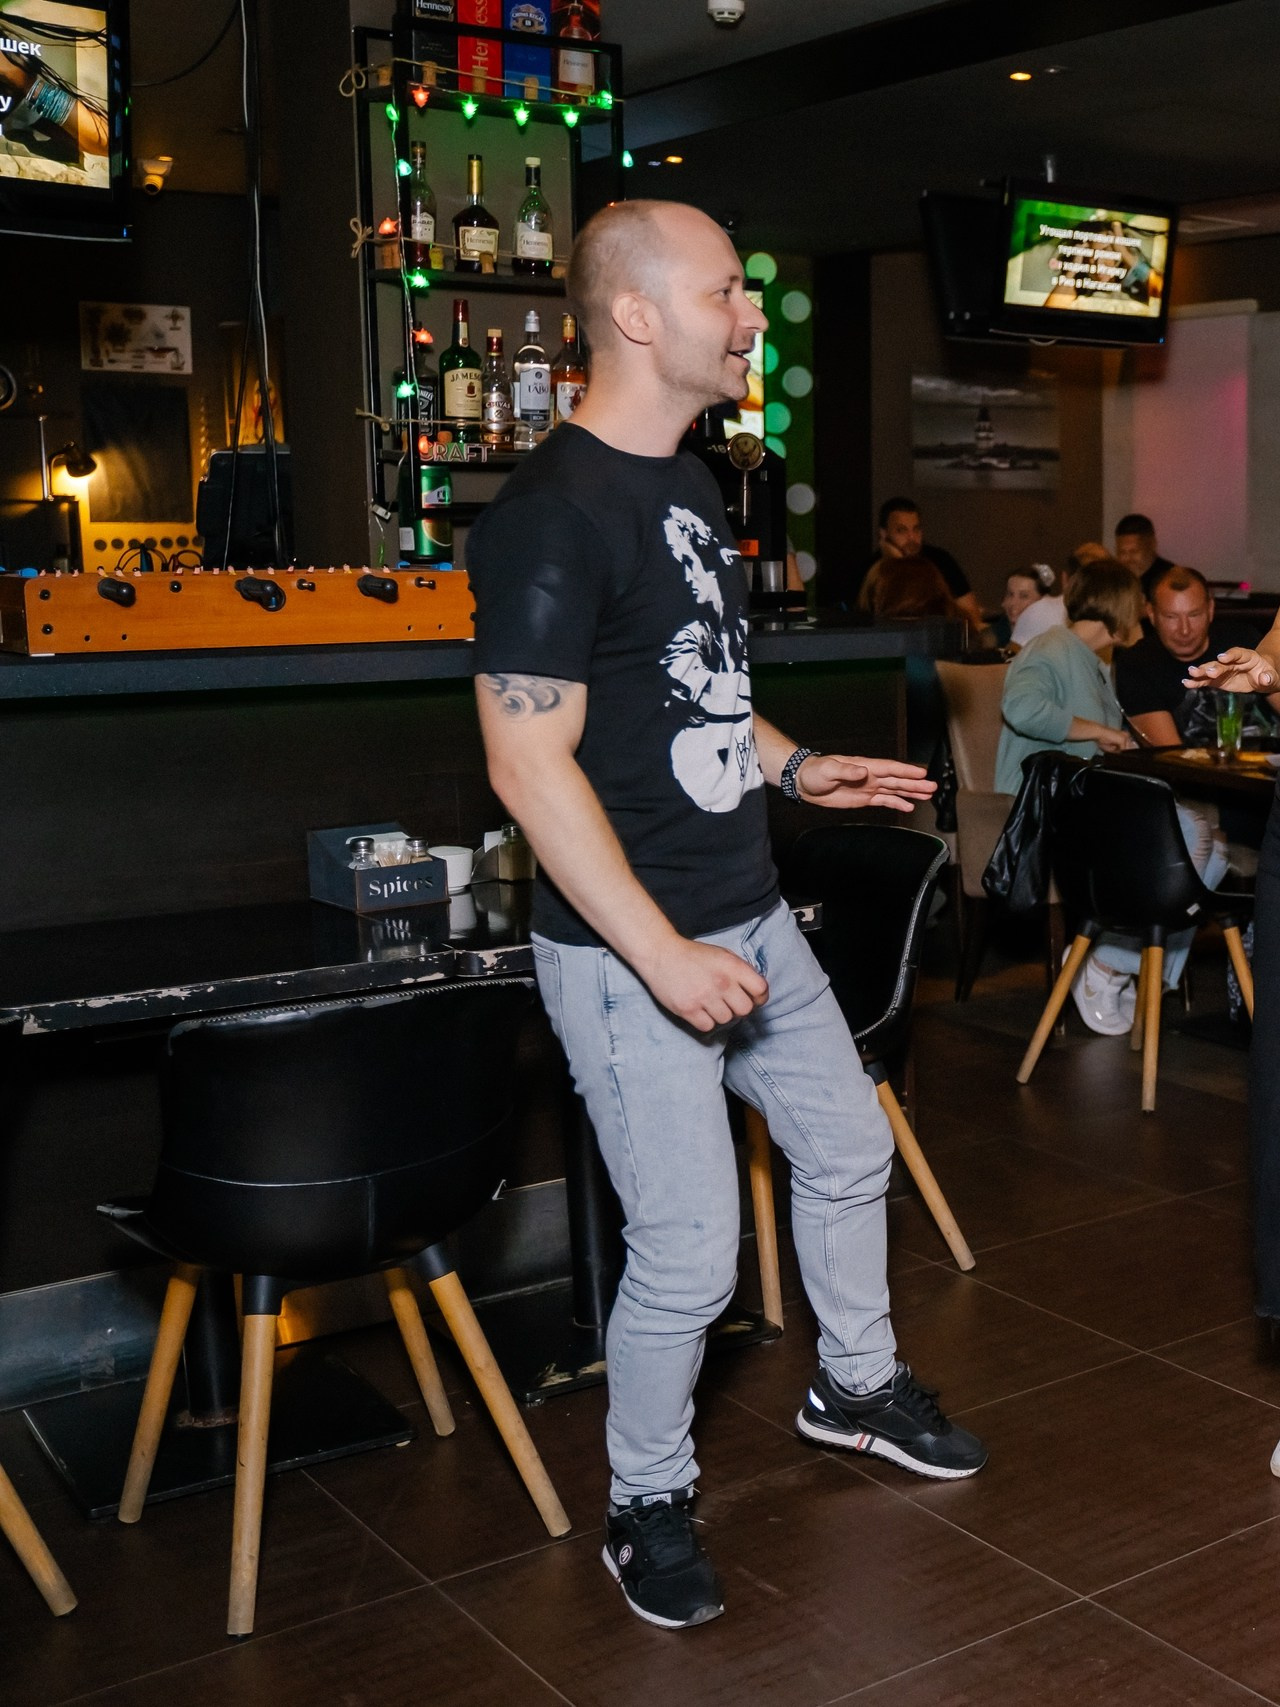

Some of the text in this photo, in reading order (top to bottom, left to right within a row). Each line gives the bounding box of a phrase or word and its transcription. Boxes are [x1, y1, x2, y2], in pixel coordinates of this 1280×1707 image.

[416, 0, 453, 13] Hennessy
[450, 372, 480, 382] JAMES
[420, 442, 491, 463] CRAFT
[369, 874, 433, 898] Spices
